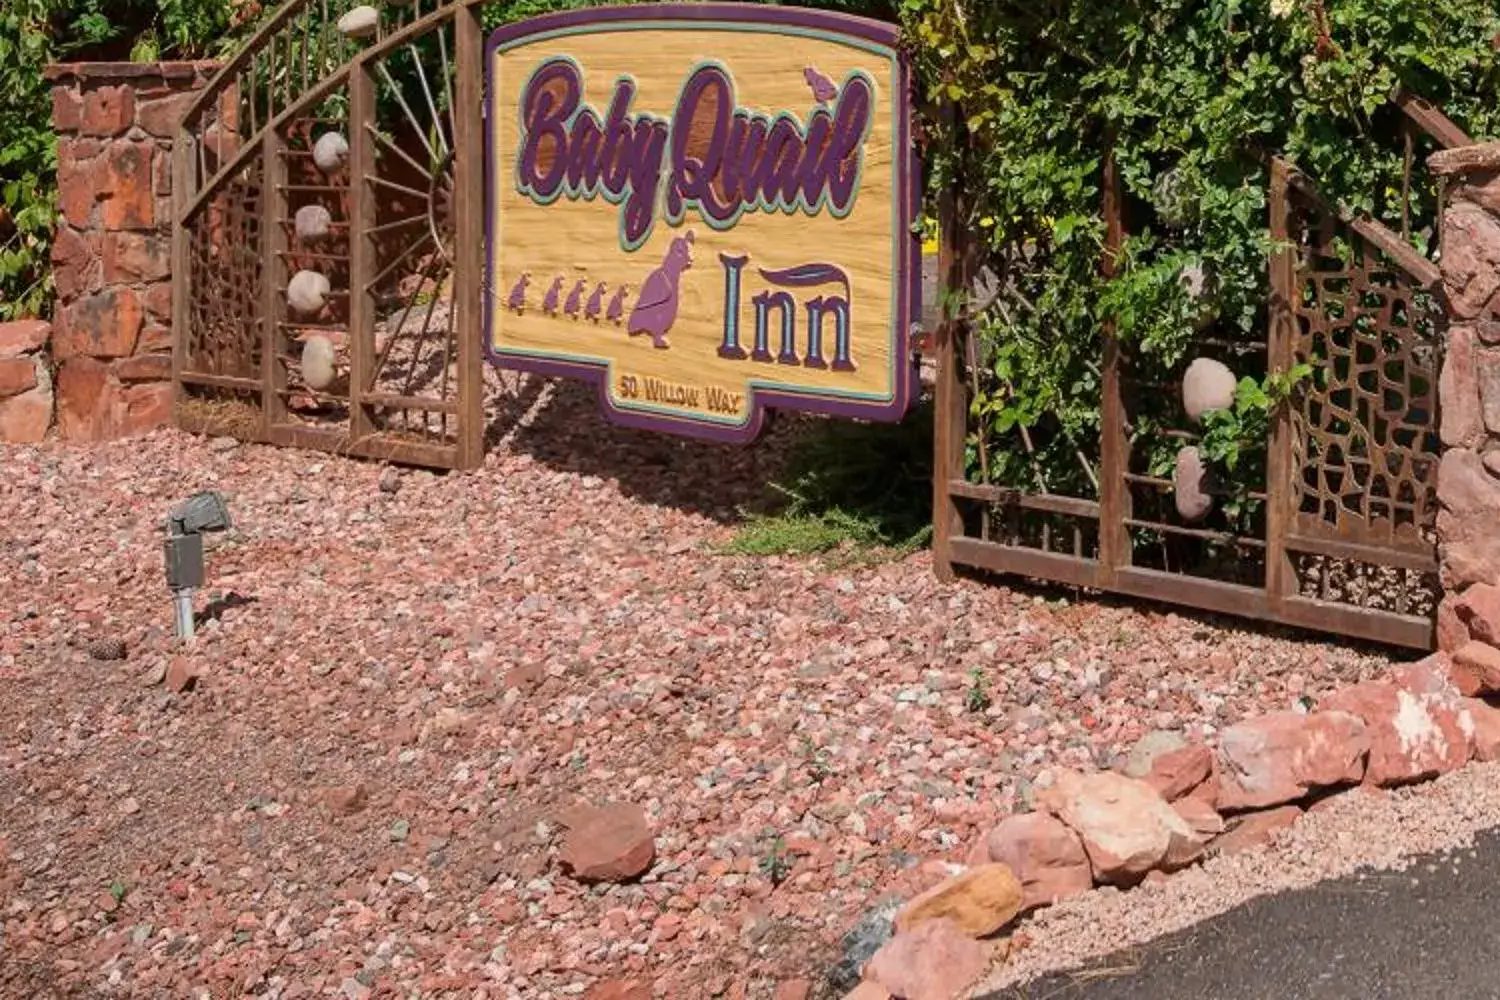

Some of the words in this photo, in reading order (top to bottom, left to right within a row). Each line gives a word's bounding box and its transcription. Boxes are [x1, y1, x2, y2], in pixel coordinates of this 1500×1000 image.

[518, 56, 668, 249] Baby
[666, 62, 873, 229] Quail
[717, 252, 857, 372] Inn
[620, 375, 639, 399] 50
[644, 377, 699, 408] WILLOW
[705, 385, 742, 415] WAY
